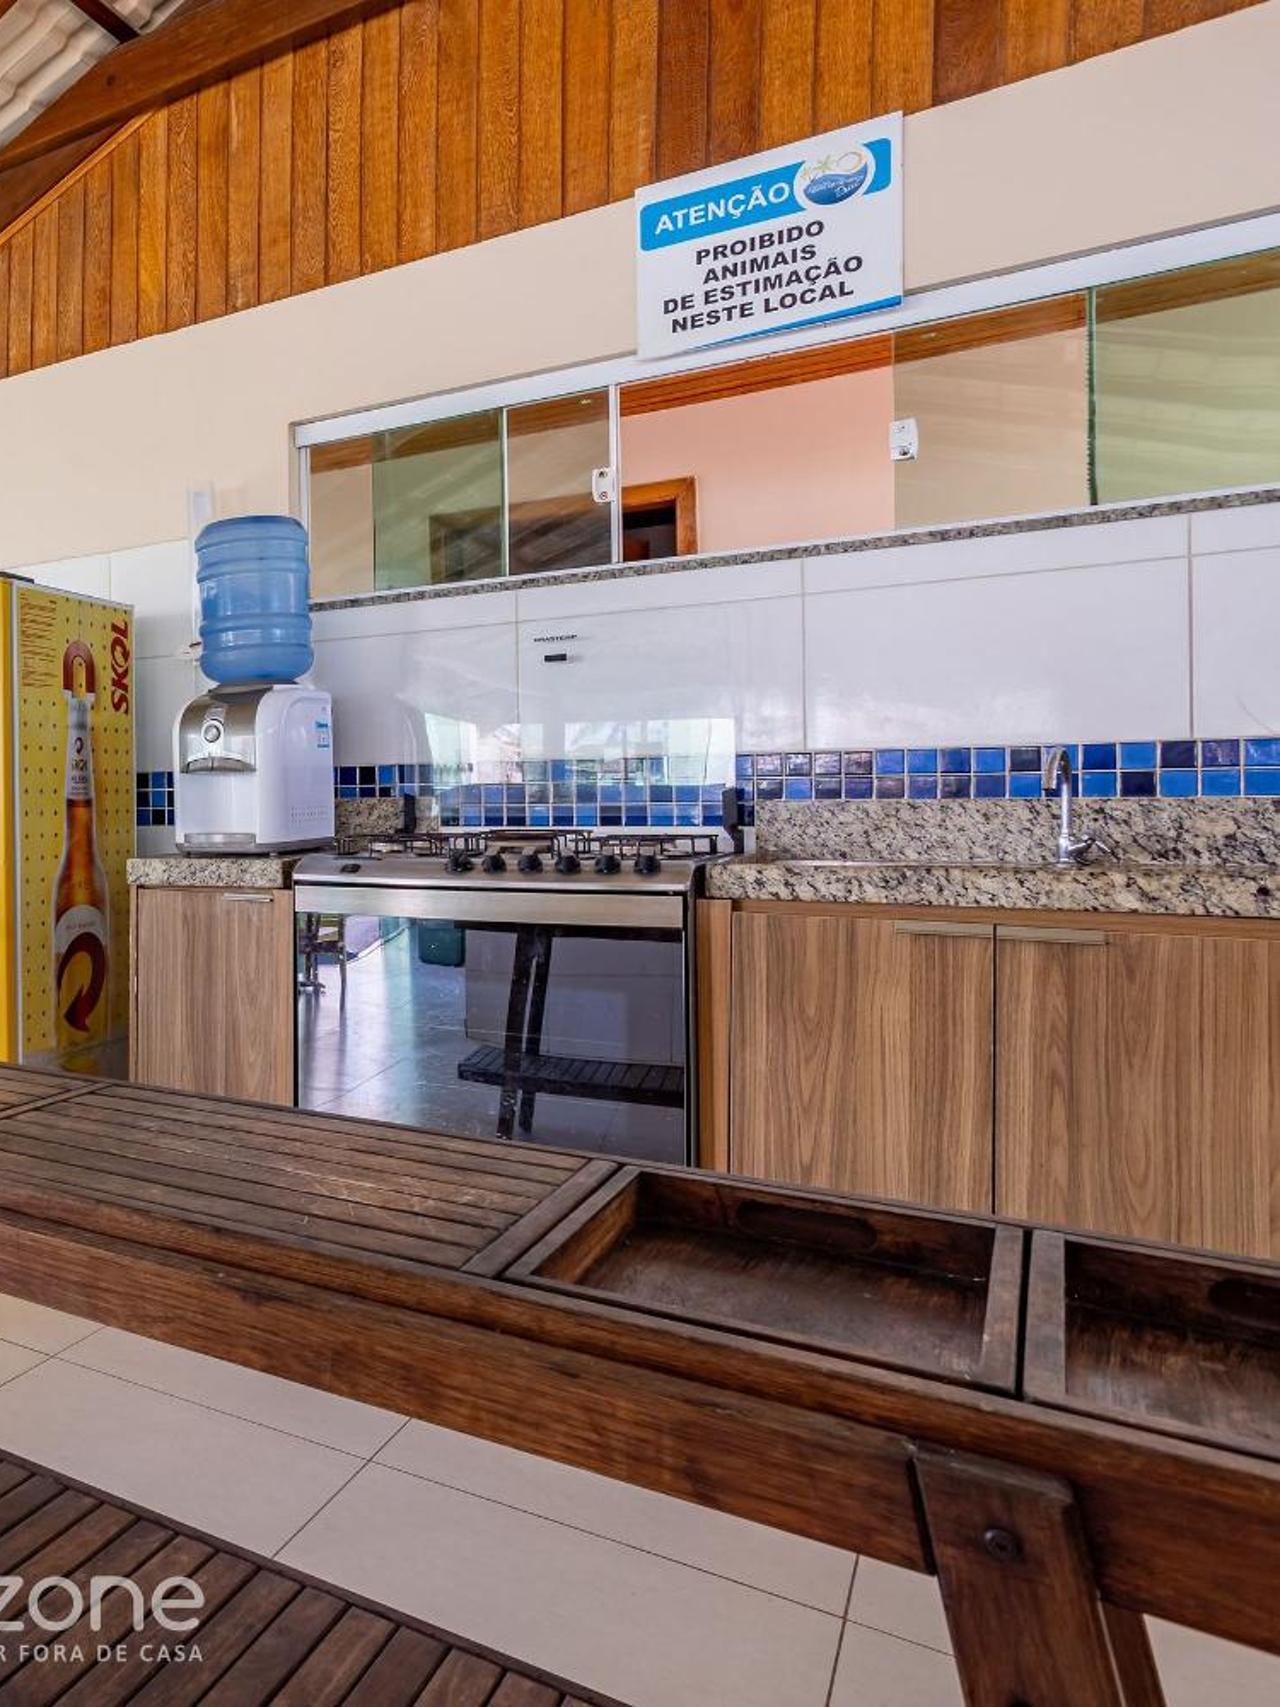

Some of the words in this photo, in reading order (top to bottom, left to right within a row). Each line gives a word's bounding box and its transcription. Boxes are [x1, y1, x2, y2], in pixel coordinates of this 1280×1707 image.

[655, 182, 790, 236] ATENÇÃO
[696, 220, 825, 265] PROIBIDO
[703, 244, 817, 285] ANIMAIS
[663, 294, 694, 314] DE
[703, 255, 863, 305] ESTIMAÇÃO
[671, 302, 754, 333] NESTE
[764, 281, 854, 313] LOCAL
[110, 619, 130, 715] SKOL
